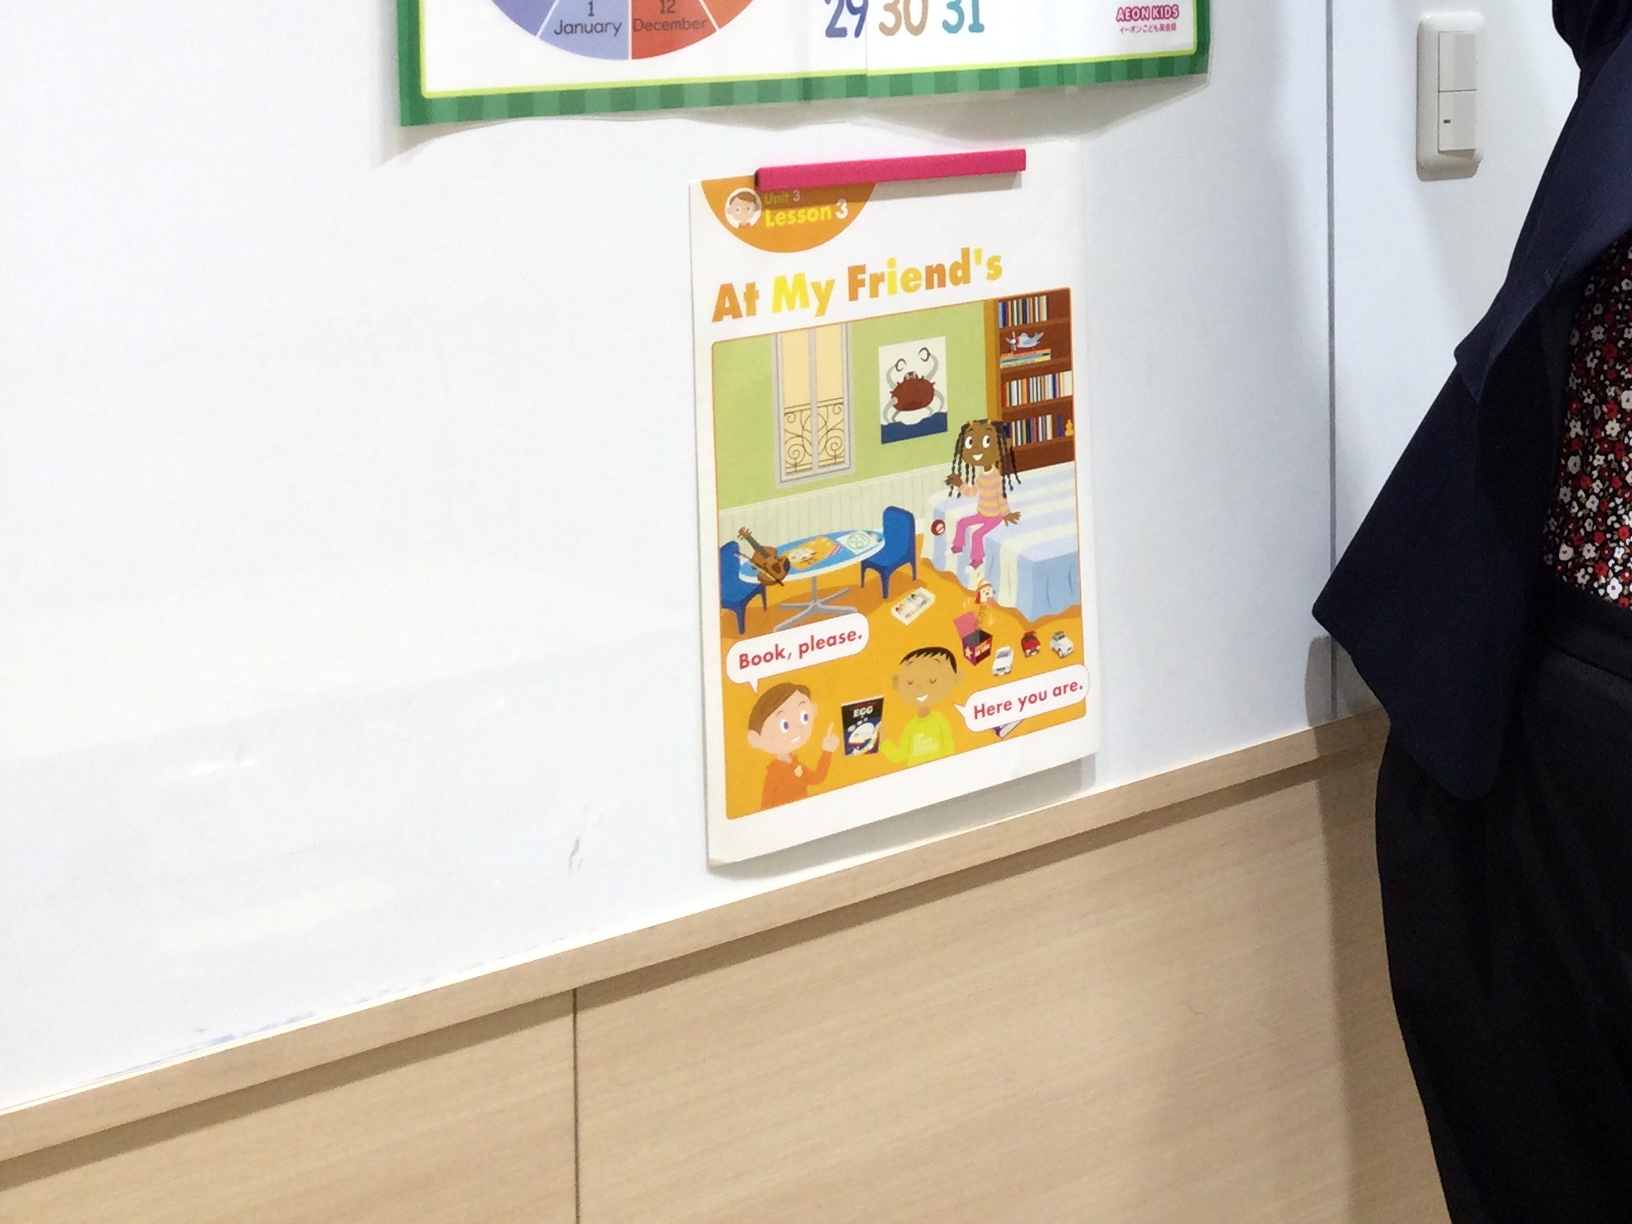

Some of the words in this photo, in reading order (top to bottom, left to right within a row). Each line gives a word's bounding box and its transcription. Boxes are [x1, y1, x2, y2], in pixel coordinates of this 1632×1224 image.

[588, 1, 594, 17] 1
[1116, 5, 1150, 22] AEON
[1151, 3, 1180, 20] KIDS
[554, 19, 622, 37] January
[633, 17, 707, 32] December
[764, 191, 789, 205] Unit
[793, 189, 800, 202] 3
[765, 206, 831, 227] Lesson
[836, 199, 848, 219] 3
[712, 280, 759, 322] At
[771, 273, 835, 316] My
[848, 247, 1002, 302] Friend's
[739, 644, 792, 669] Book,
[798, 626, 863, 663] please.
[973, 698, 1012, 720] Here
[1018, 692, 1048, 713] you
[1053, 680, 1083, 702] are.
